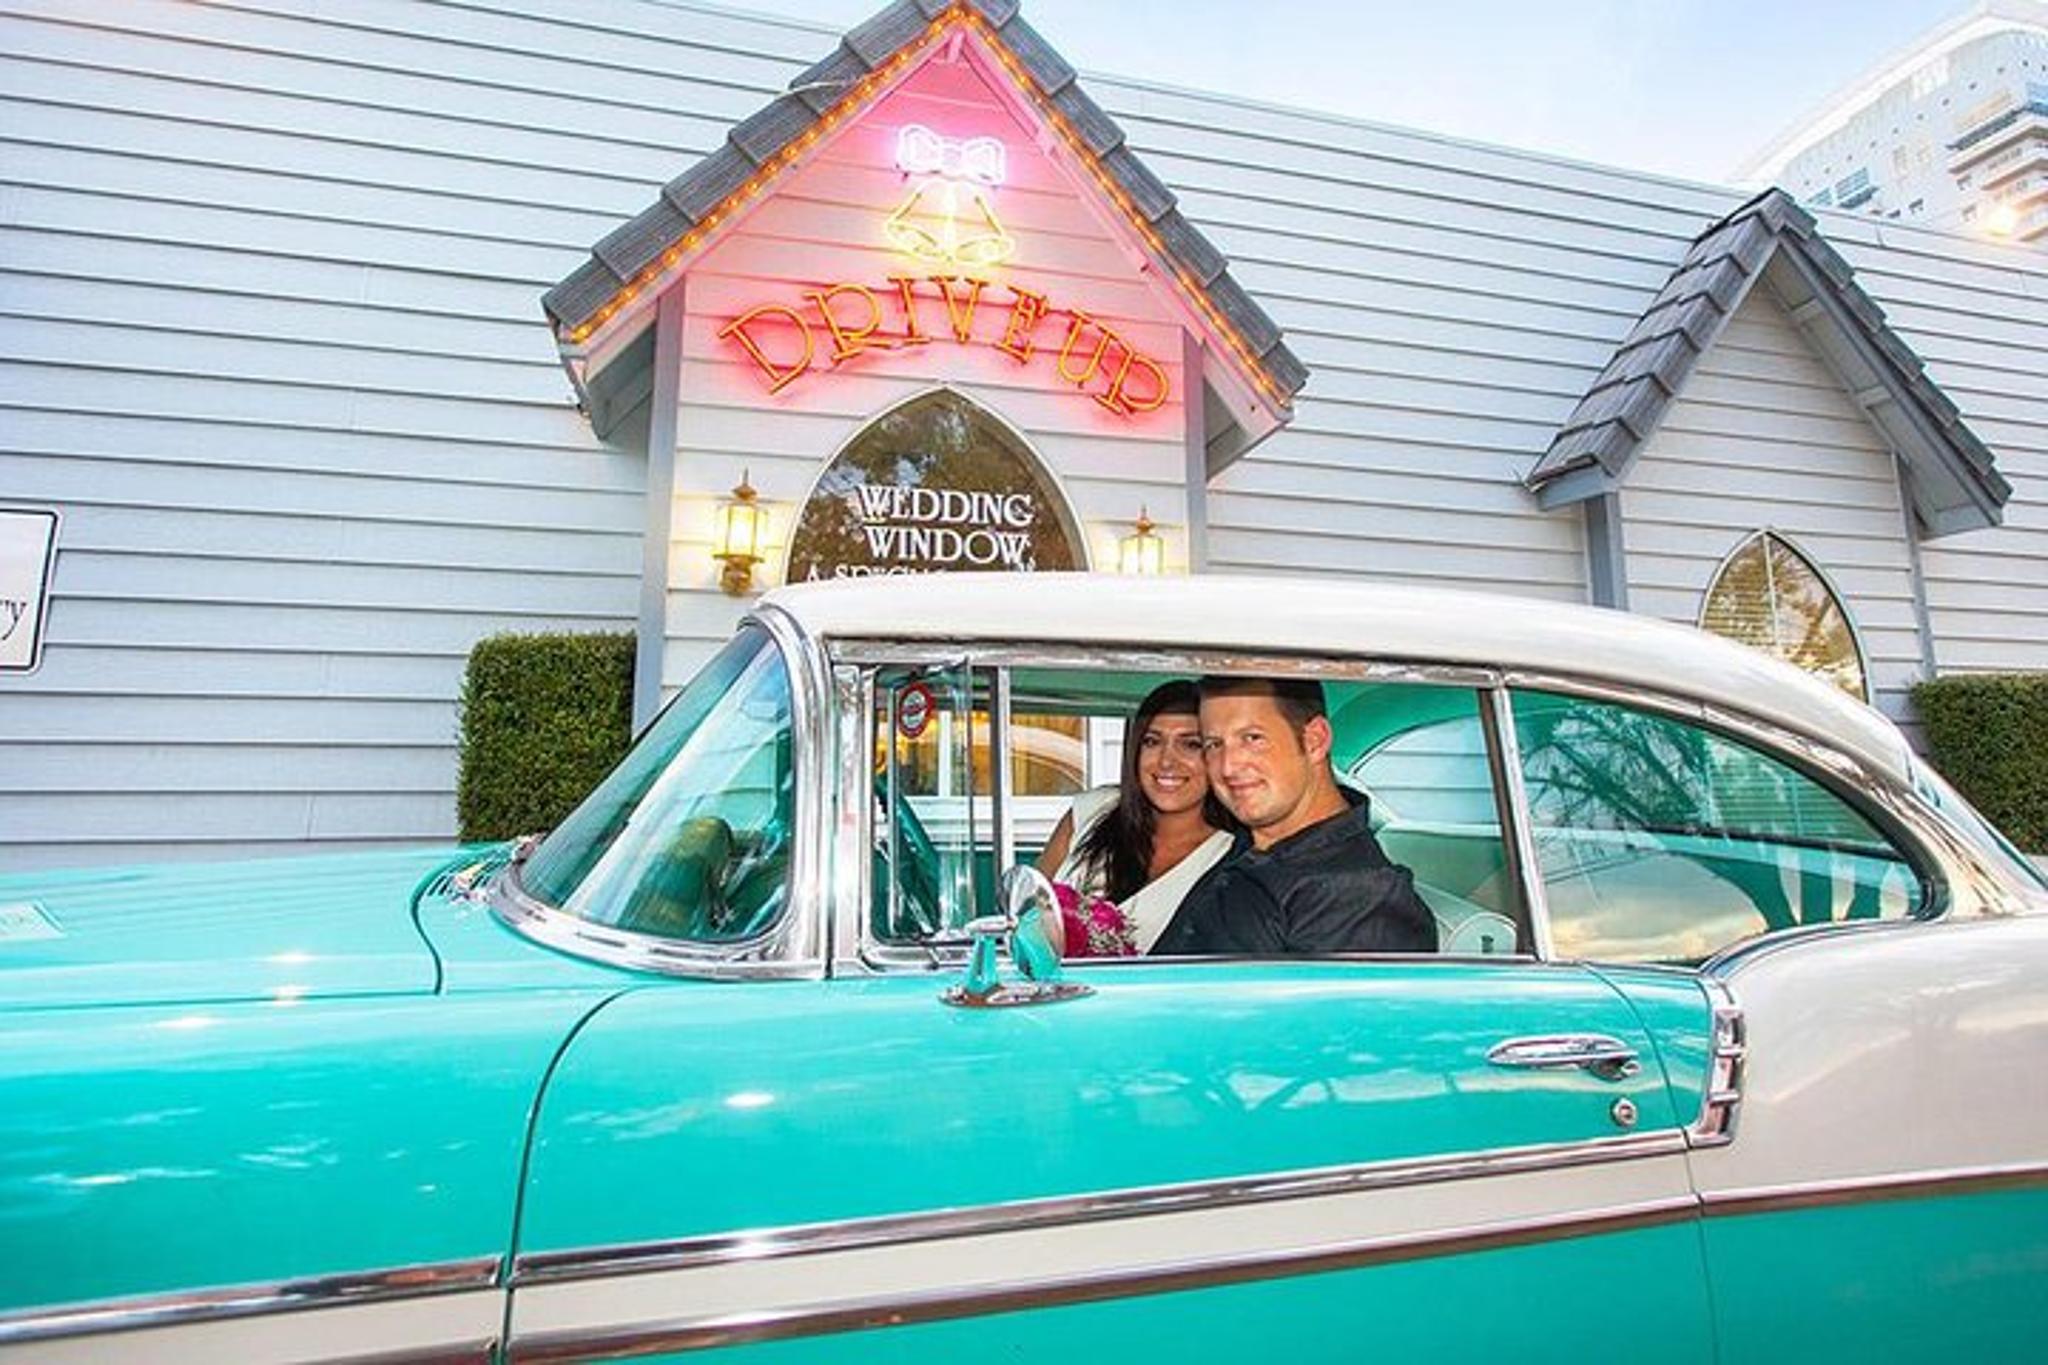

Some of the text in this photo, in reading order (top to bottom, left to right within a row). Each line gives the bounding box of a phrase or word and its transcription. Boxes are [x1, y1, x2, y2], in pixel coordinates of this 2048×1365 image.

[716, 275, 1169, 415] DRIVE UP
[856, 484, 1035, 527] WEDDING
[863, 525, 1031, 565] WINDOW
